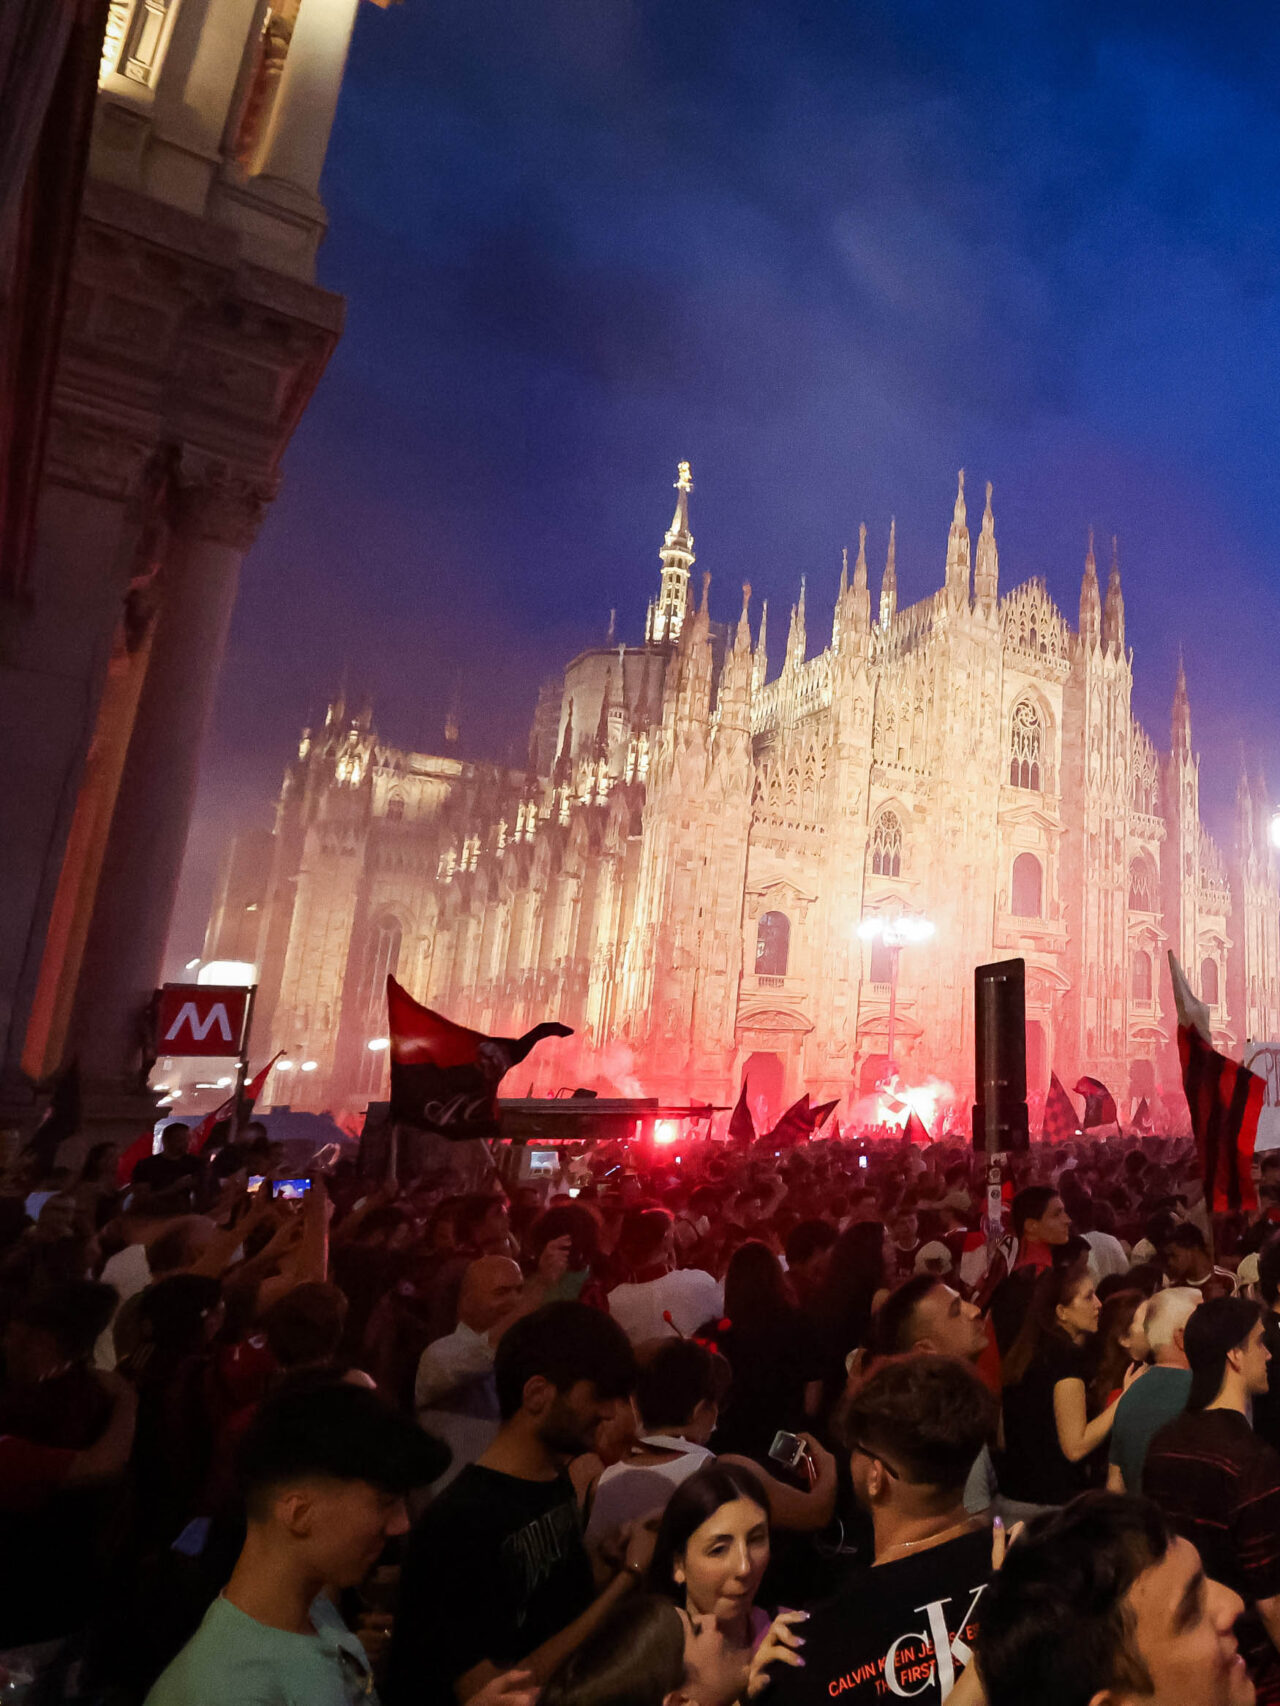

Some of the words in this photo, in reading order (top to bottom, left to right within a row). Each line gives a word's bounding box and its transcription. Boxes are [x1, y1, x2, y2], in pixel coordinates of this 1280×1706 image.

[164, 1002, 232, 1041] M
[828, 1662, 876, 1697] CALVIN
[878, 1646, 915, 1673] KEIN
[918, 1631, 956, 1658] JES
[901, 1660, 937, 1686] FIRST
